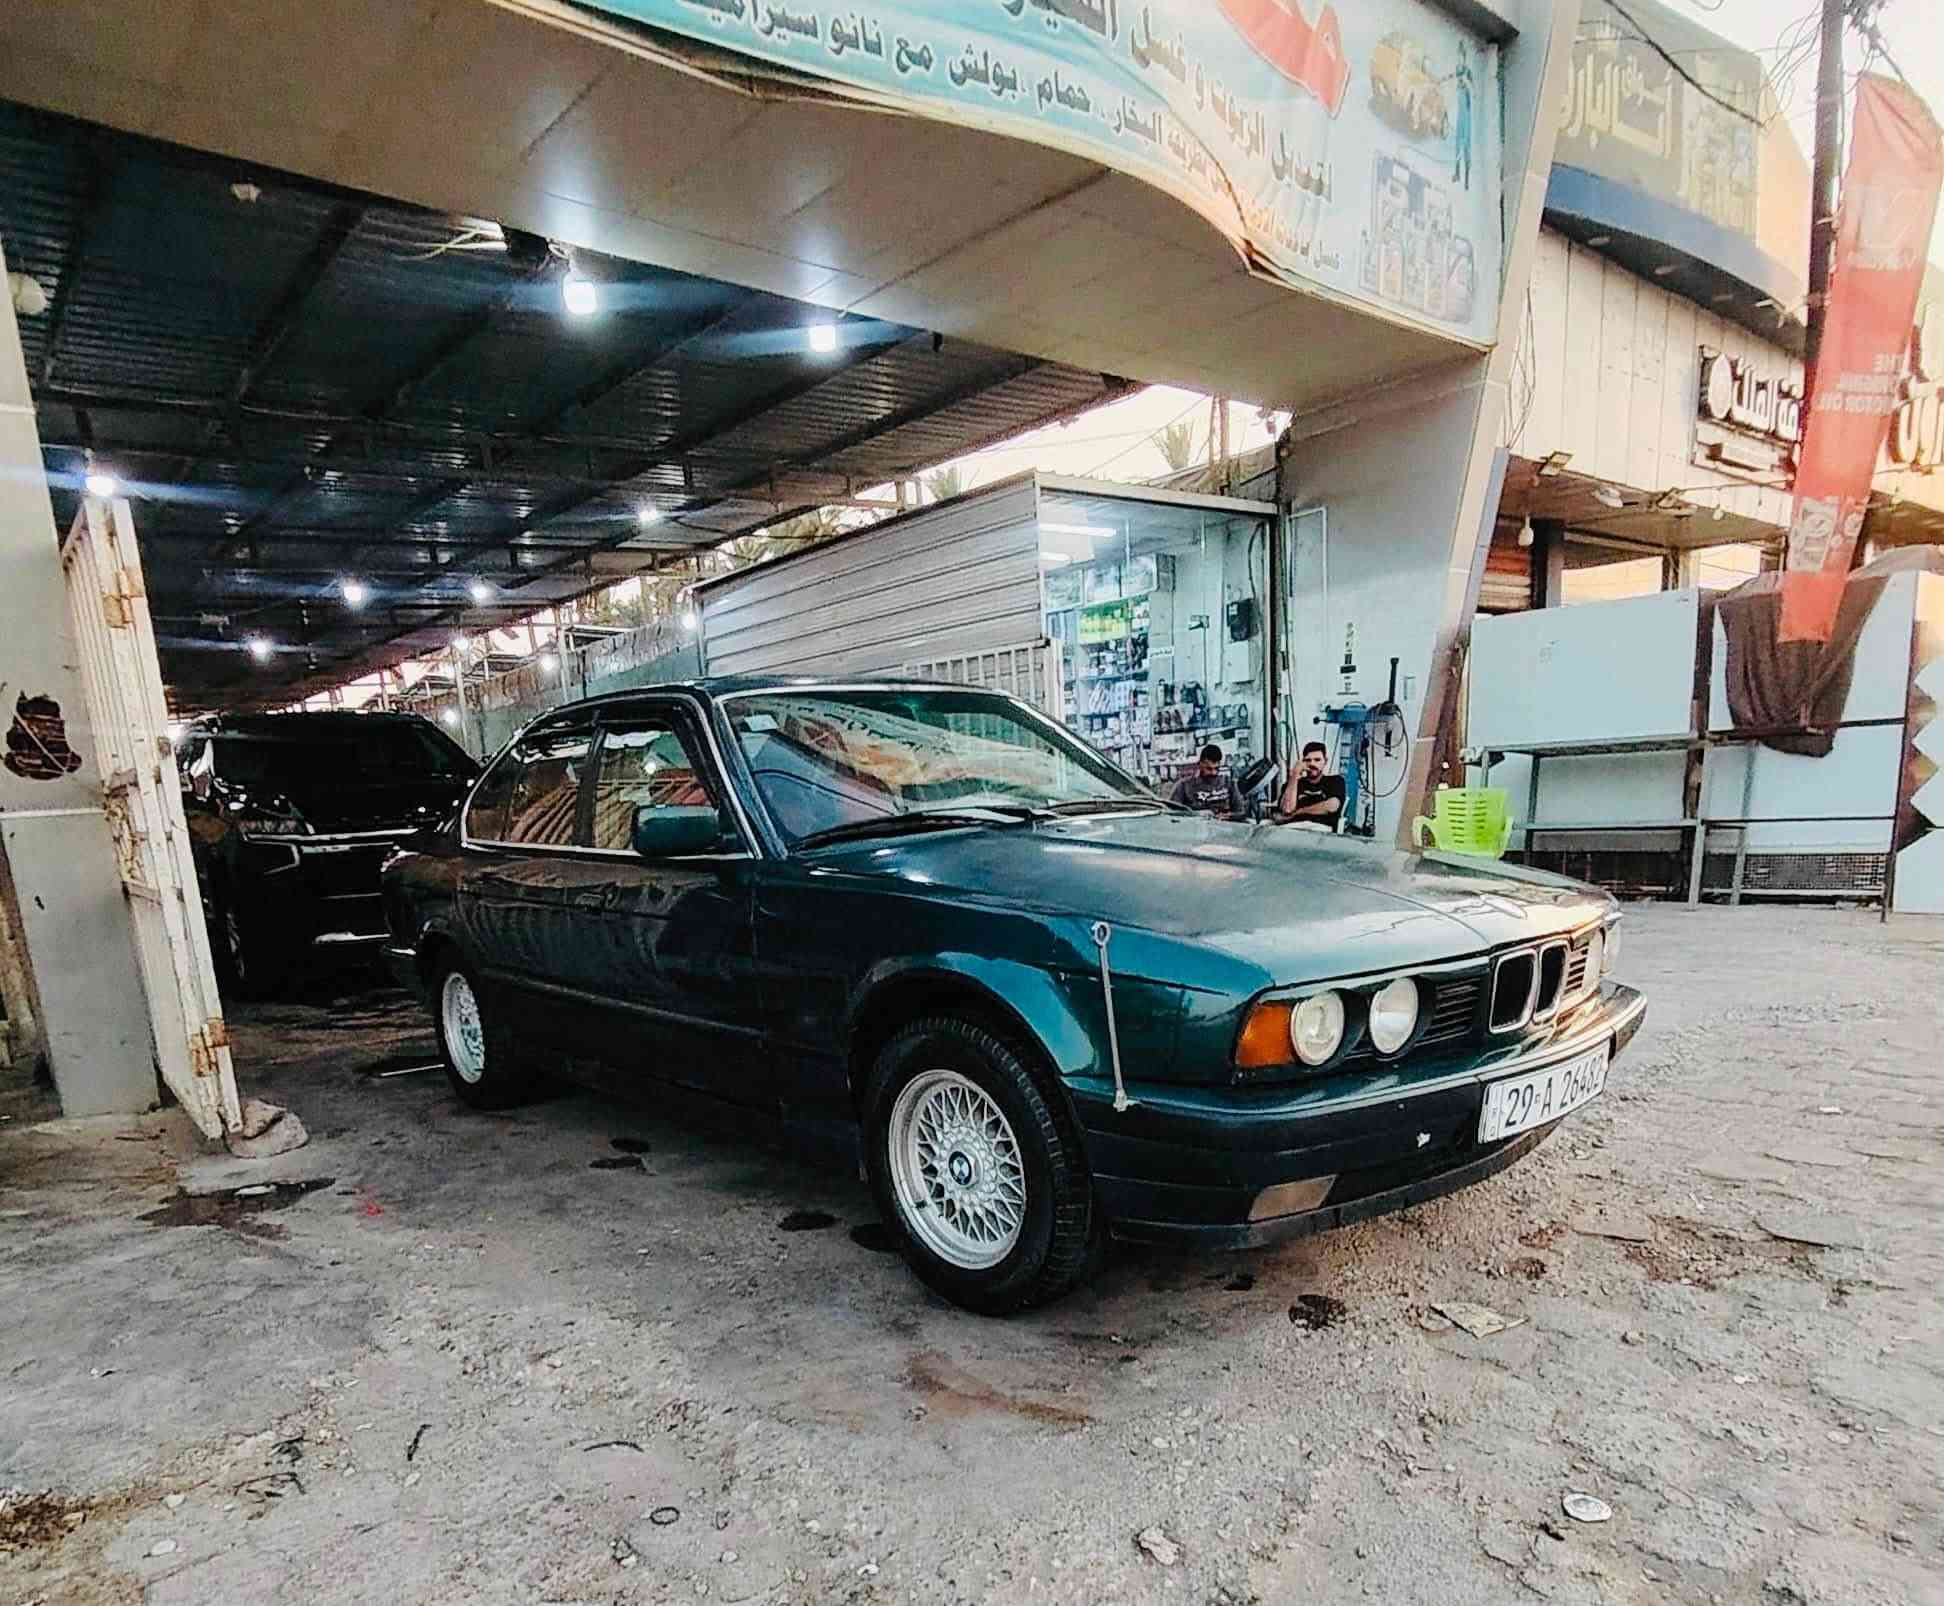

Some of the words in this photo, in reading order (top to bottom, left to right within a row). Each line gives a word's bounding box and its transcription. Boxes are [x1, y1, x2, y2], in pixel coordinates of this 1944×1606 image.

[829, 13, 884, 56] نانو
[894, 37, 934, 73] مع
[949, 43, 1018, 98] بولش
[1037, 69, 1091, 113] حمام
[1504, 1083, 1534, 1128] 29
[1540, 1077, 1553, 1118] A
